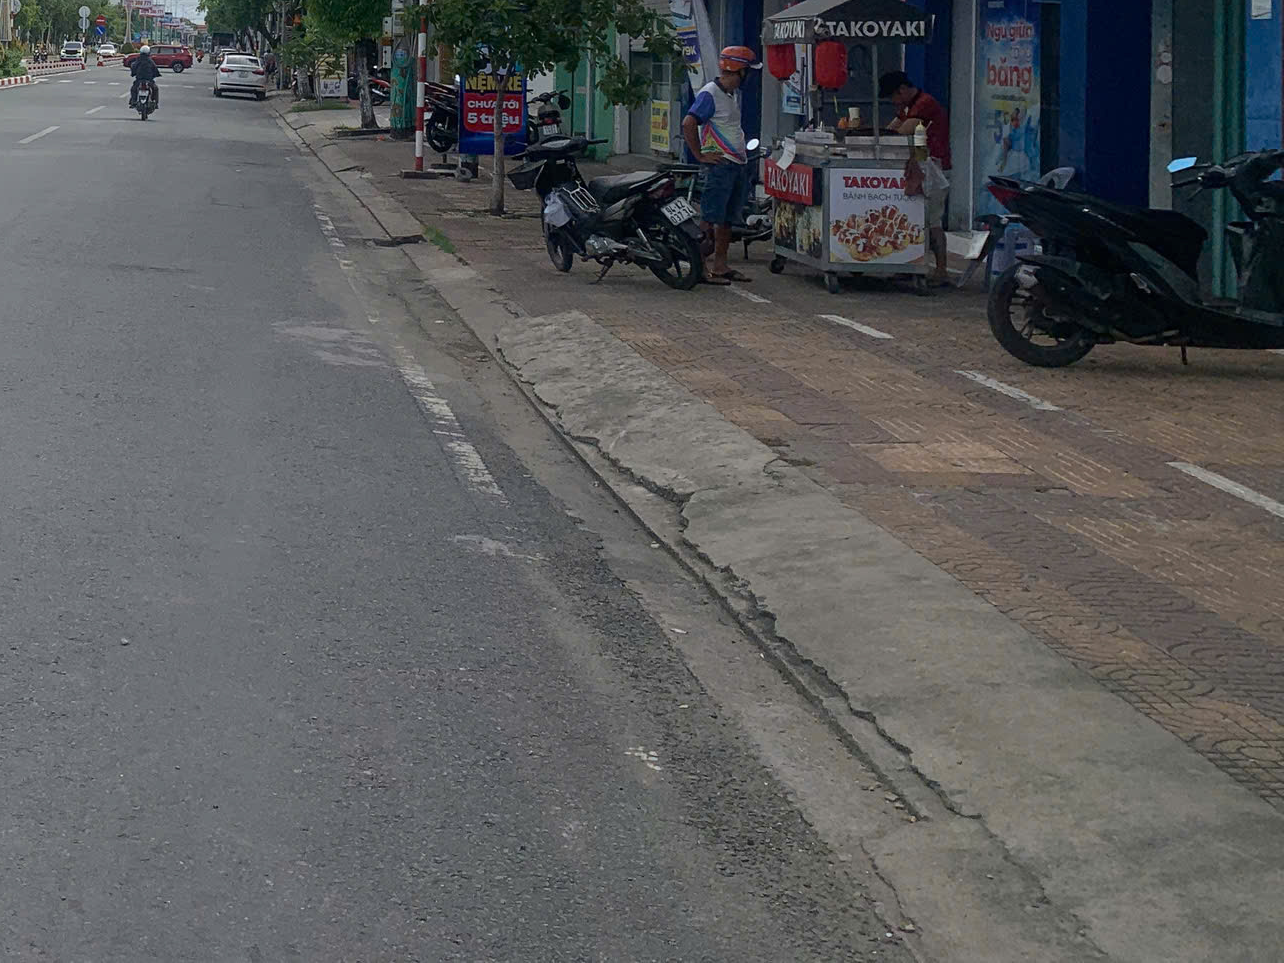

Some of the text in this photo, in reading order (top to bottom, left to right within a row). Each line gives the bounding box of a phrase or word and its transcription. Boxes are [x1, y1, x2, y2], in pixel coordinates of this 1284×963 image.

[774, 20, 805, 39] TAKOYAKI
[826, 20, 925, 37] TAKOYAKI
[467, 112, 519, 127] 5 trệu
[767, 166, 809, 196] TAKOYAKI
